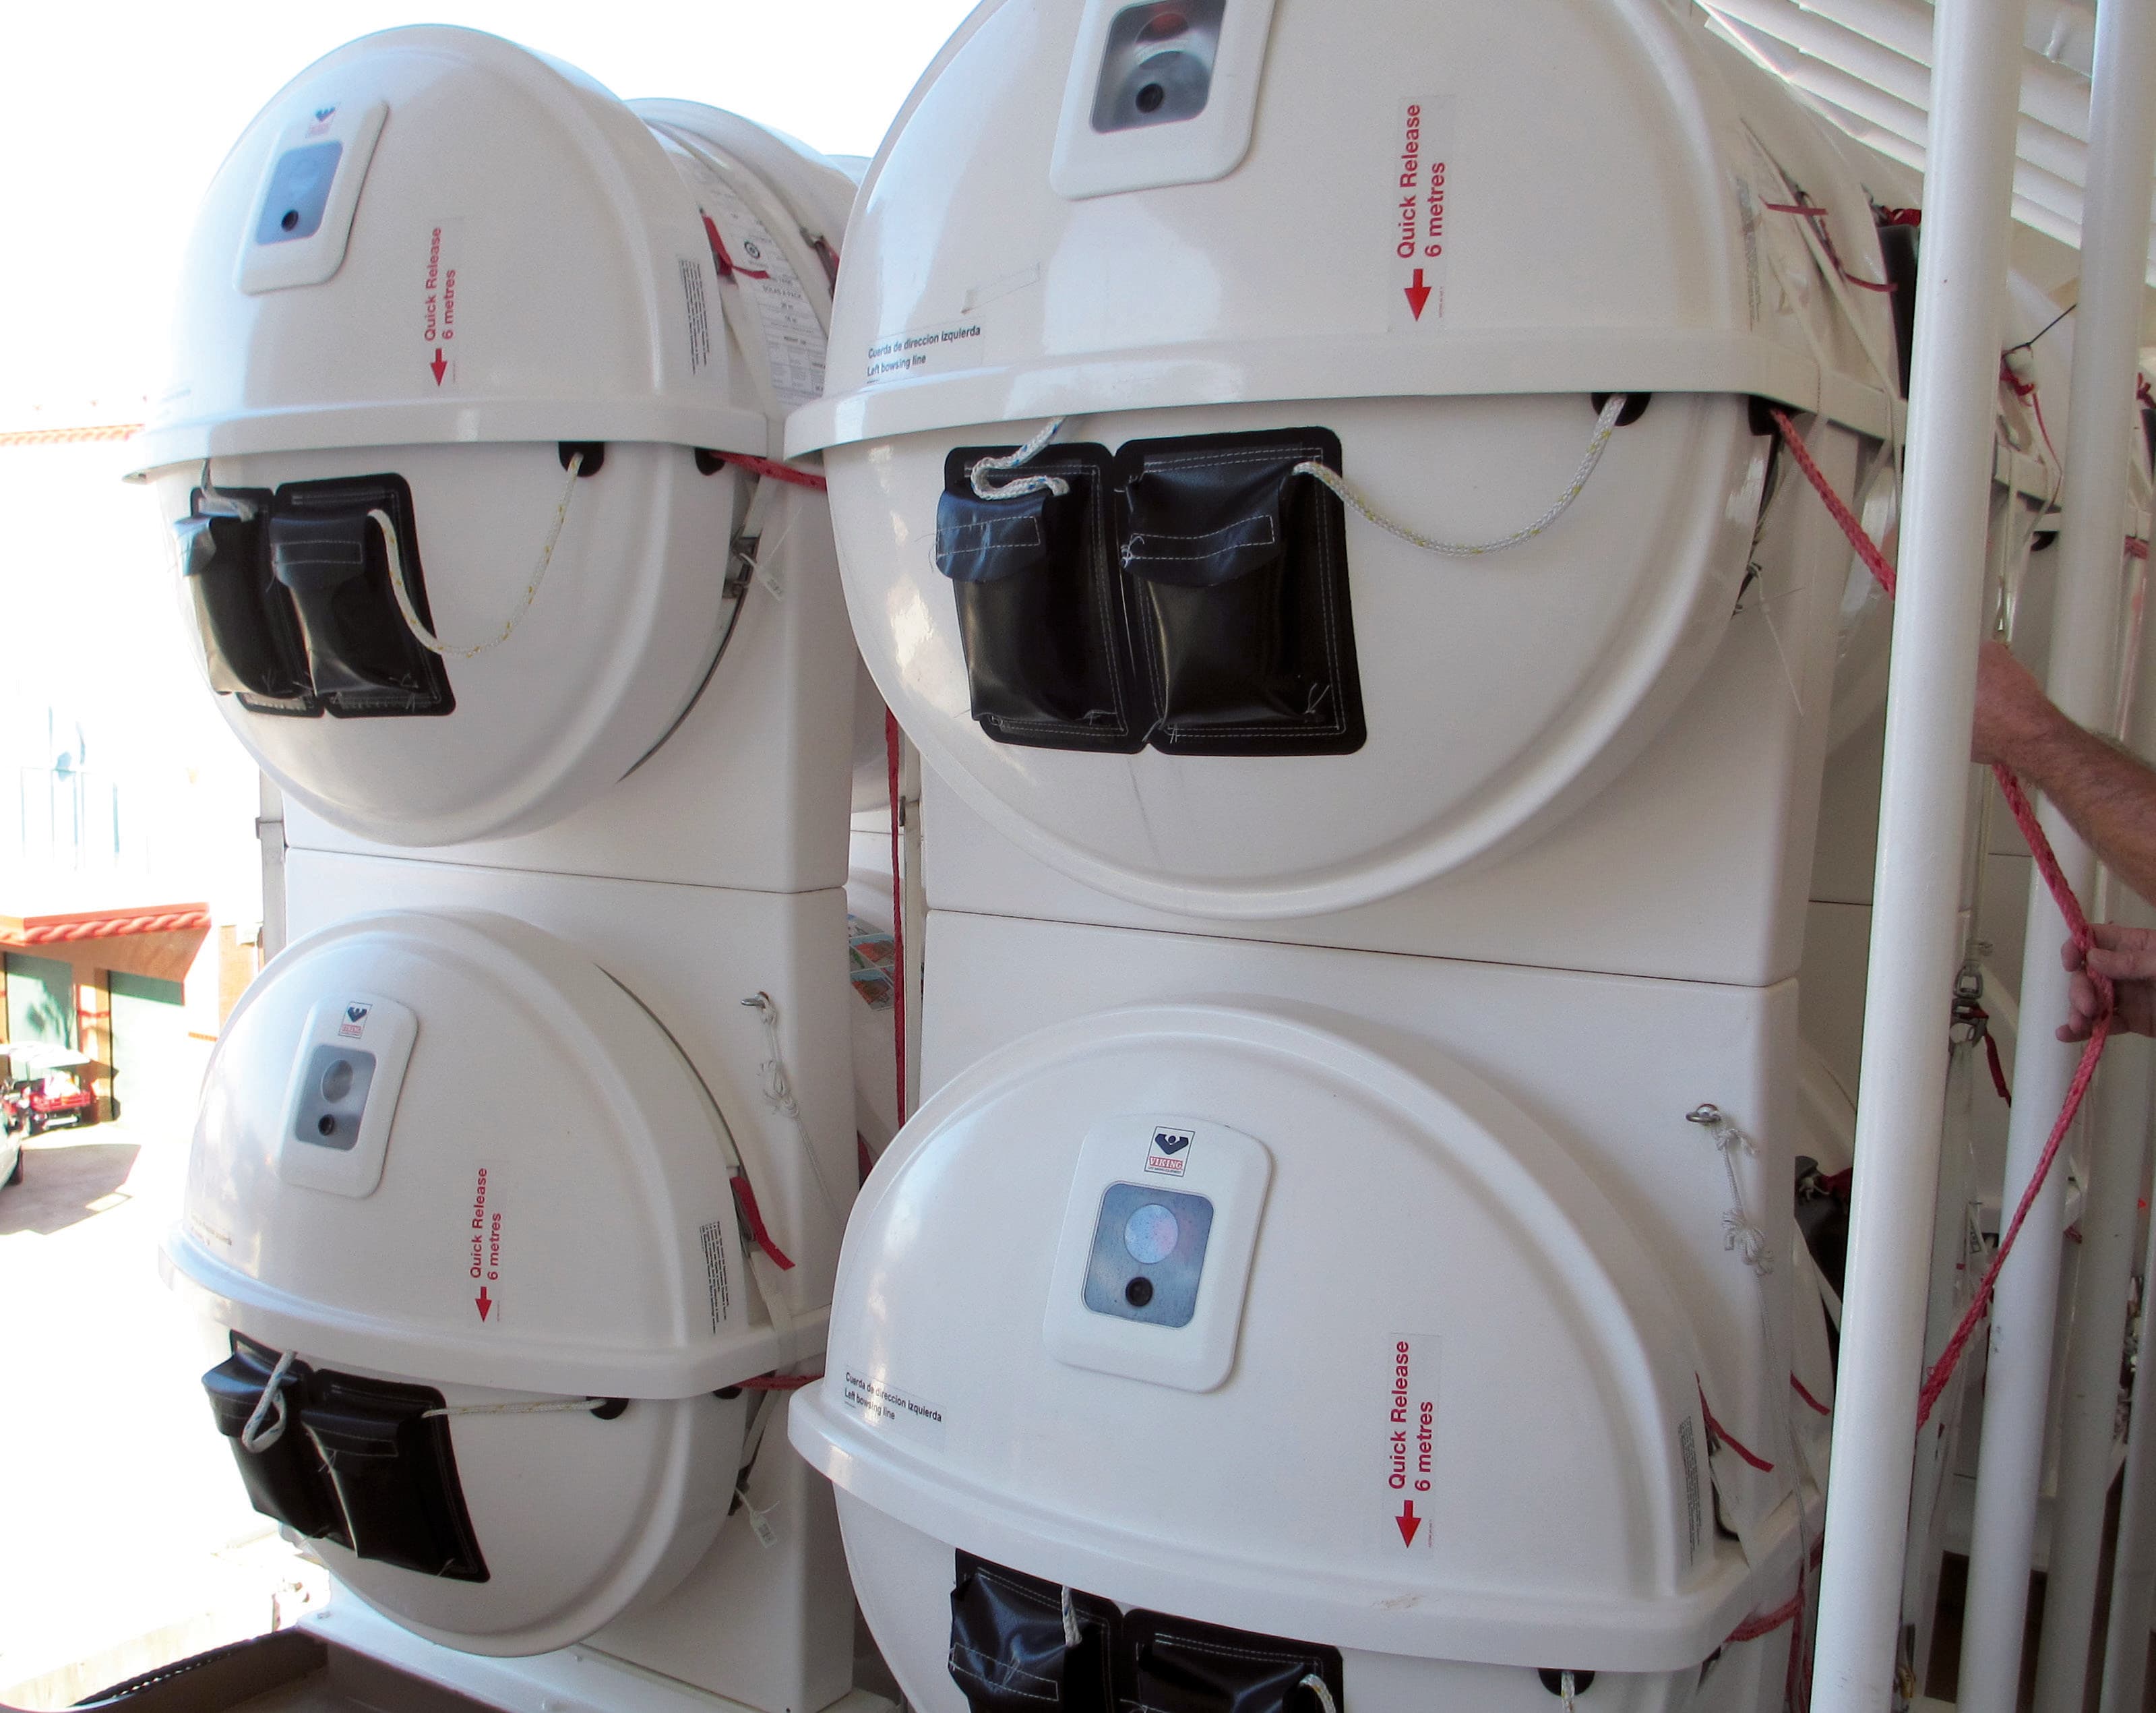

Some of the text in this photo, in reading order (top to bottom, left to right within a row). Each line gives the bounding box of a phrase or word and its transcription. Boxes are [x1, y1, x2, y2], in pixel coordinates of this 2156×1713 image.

[1397, 104, 1421, 259] Quick Release
[1425, 162, 1446, 258] 6 metres
[425, 228, 442, 342] Quick Release
[441, 269, 456, 340] 6 metres
[867, 353, 927, 377] Left bowsing line
[868, 345, 892, 359] Cuerda
[893, 341, 902, 353] de
[904, 333, 939, 350] direccion
[1149, 1156, 1183, 1170] VIKING
[470, 1168, 487, 1278] Quick Release
[487, 1212, 502, 1280] 6 metres
[844, 1387, 855, 1401] Left
[857, 1393, 882, 1415] bowsing
[883, 1406, 895, 1420] line
[846, 1372, 865, 1389] Cuerda
[867, 1384, 874, 1394] de
[875, 1387, 906, 1408] direccion
[1388, 1340, 1409, 1489] Quick Release
[1415, 1402, 1434, 1492] 6 metres
